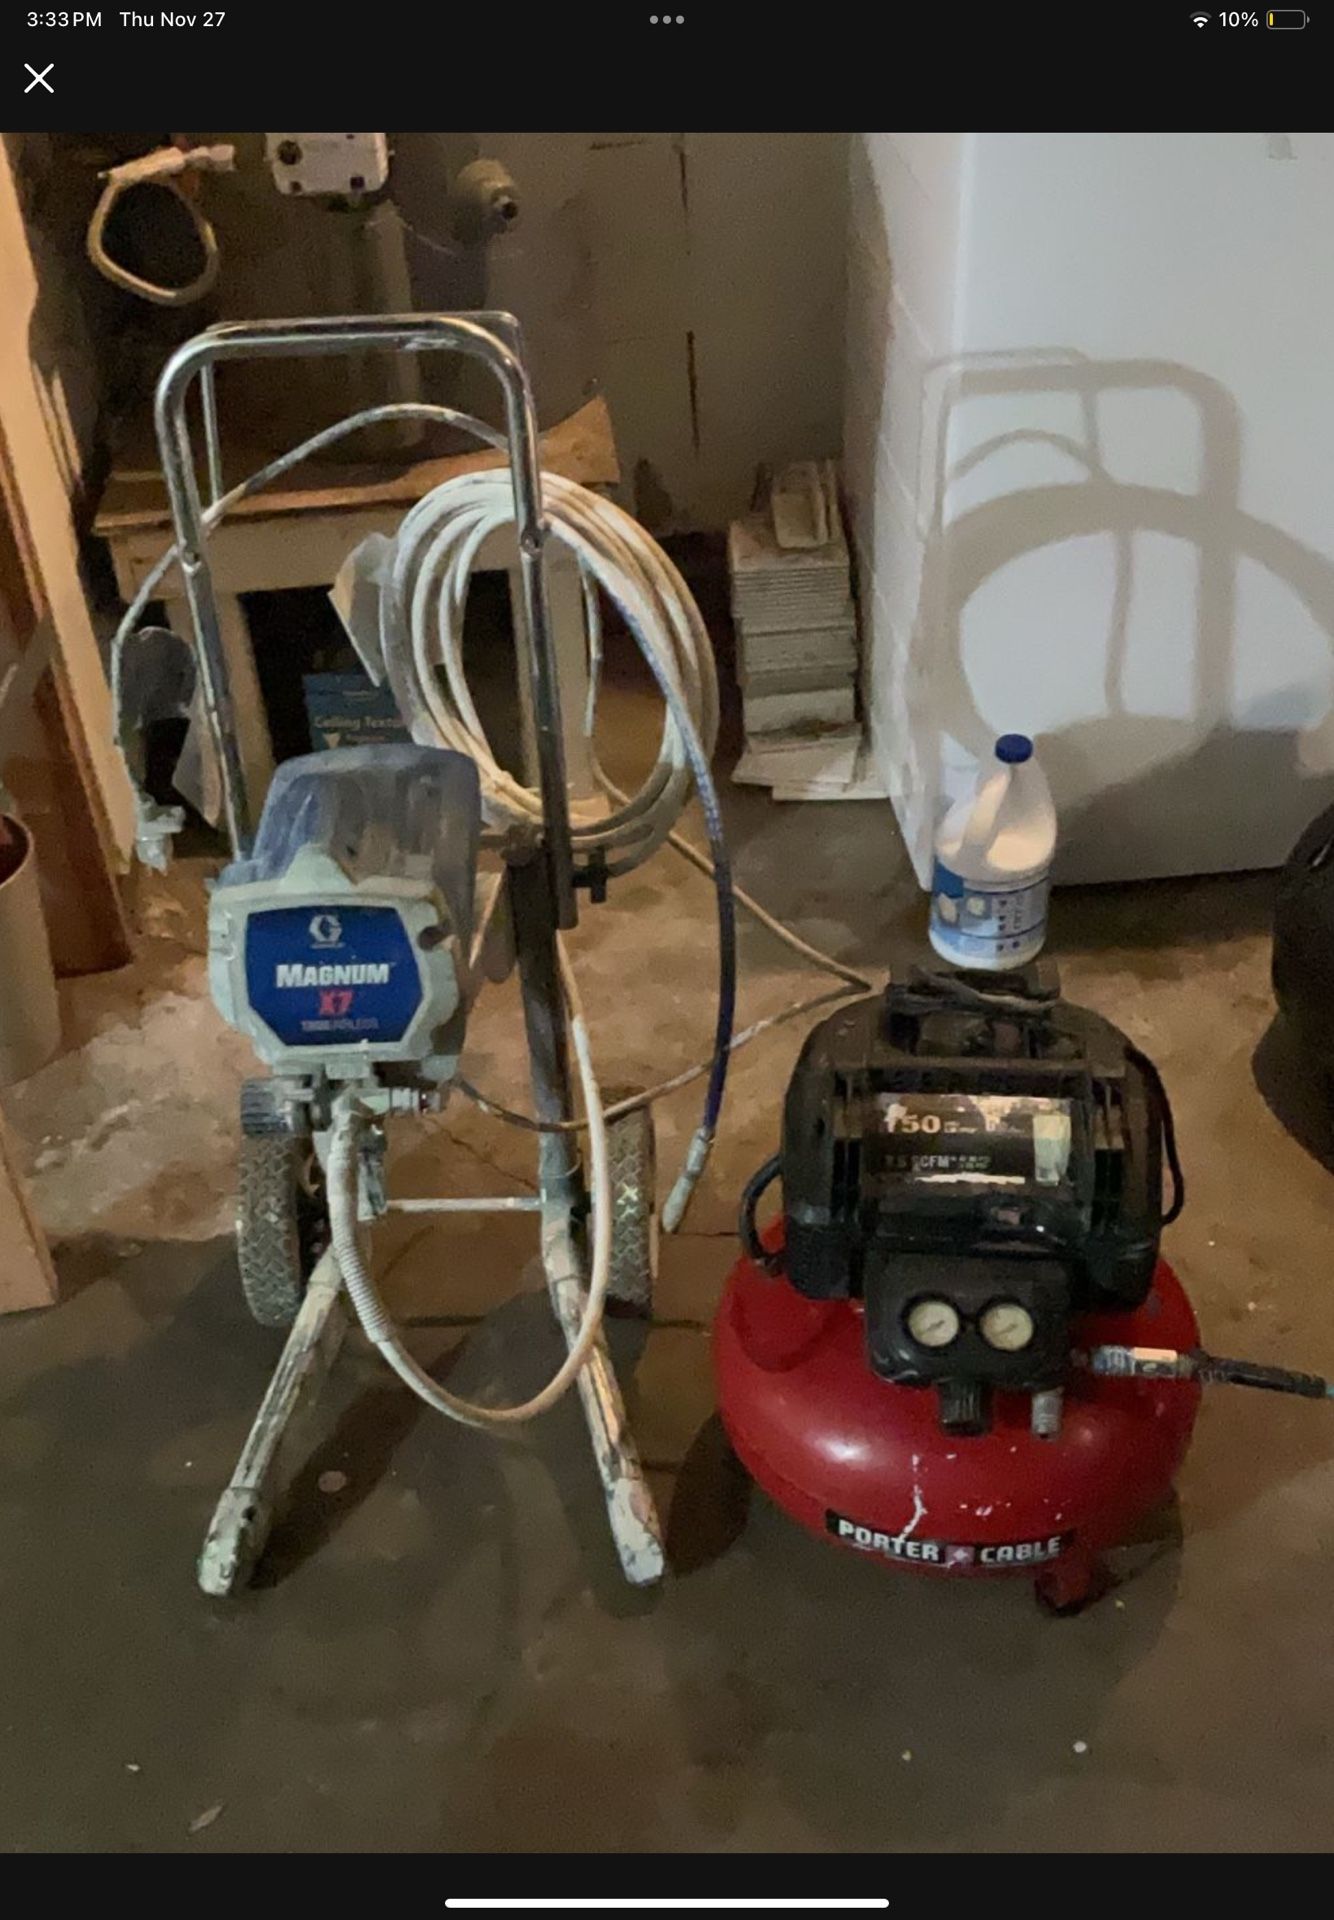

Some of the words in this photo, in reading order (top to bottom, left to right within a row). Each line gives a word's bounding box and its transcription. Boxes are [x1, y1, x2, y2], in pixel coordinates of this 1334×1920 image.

[276, 963, 390, 988] MAGNUM
[319, 990, 354, 1016] X7
[838, 1519, 939, 1562] PORTER
[980, 1536, 1061, 1563] CABLE
